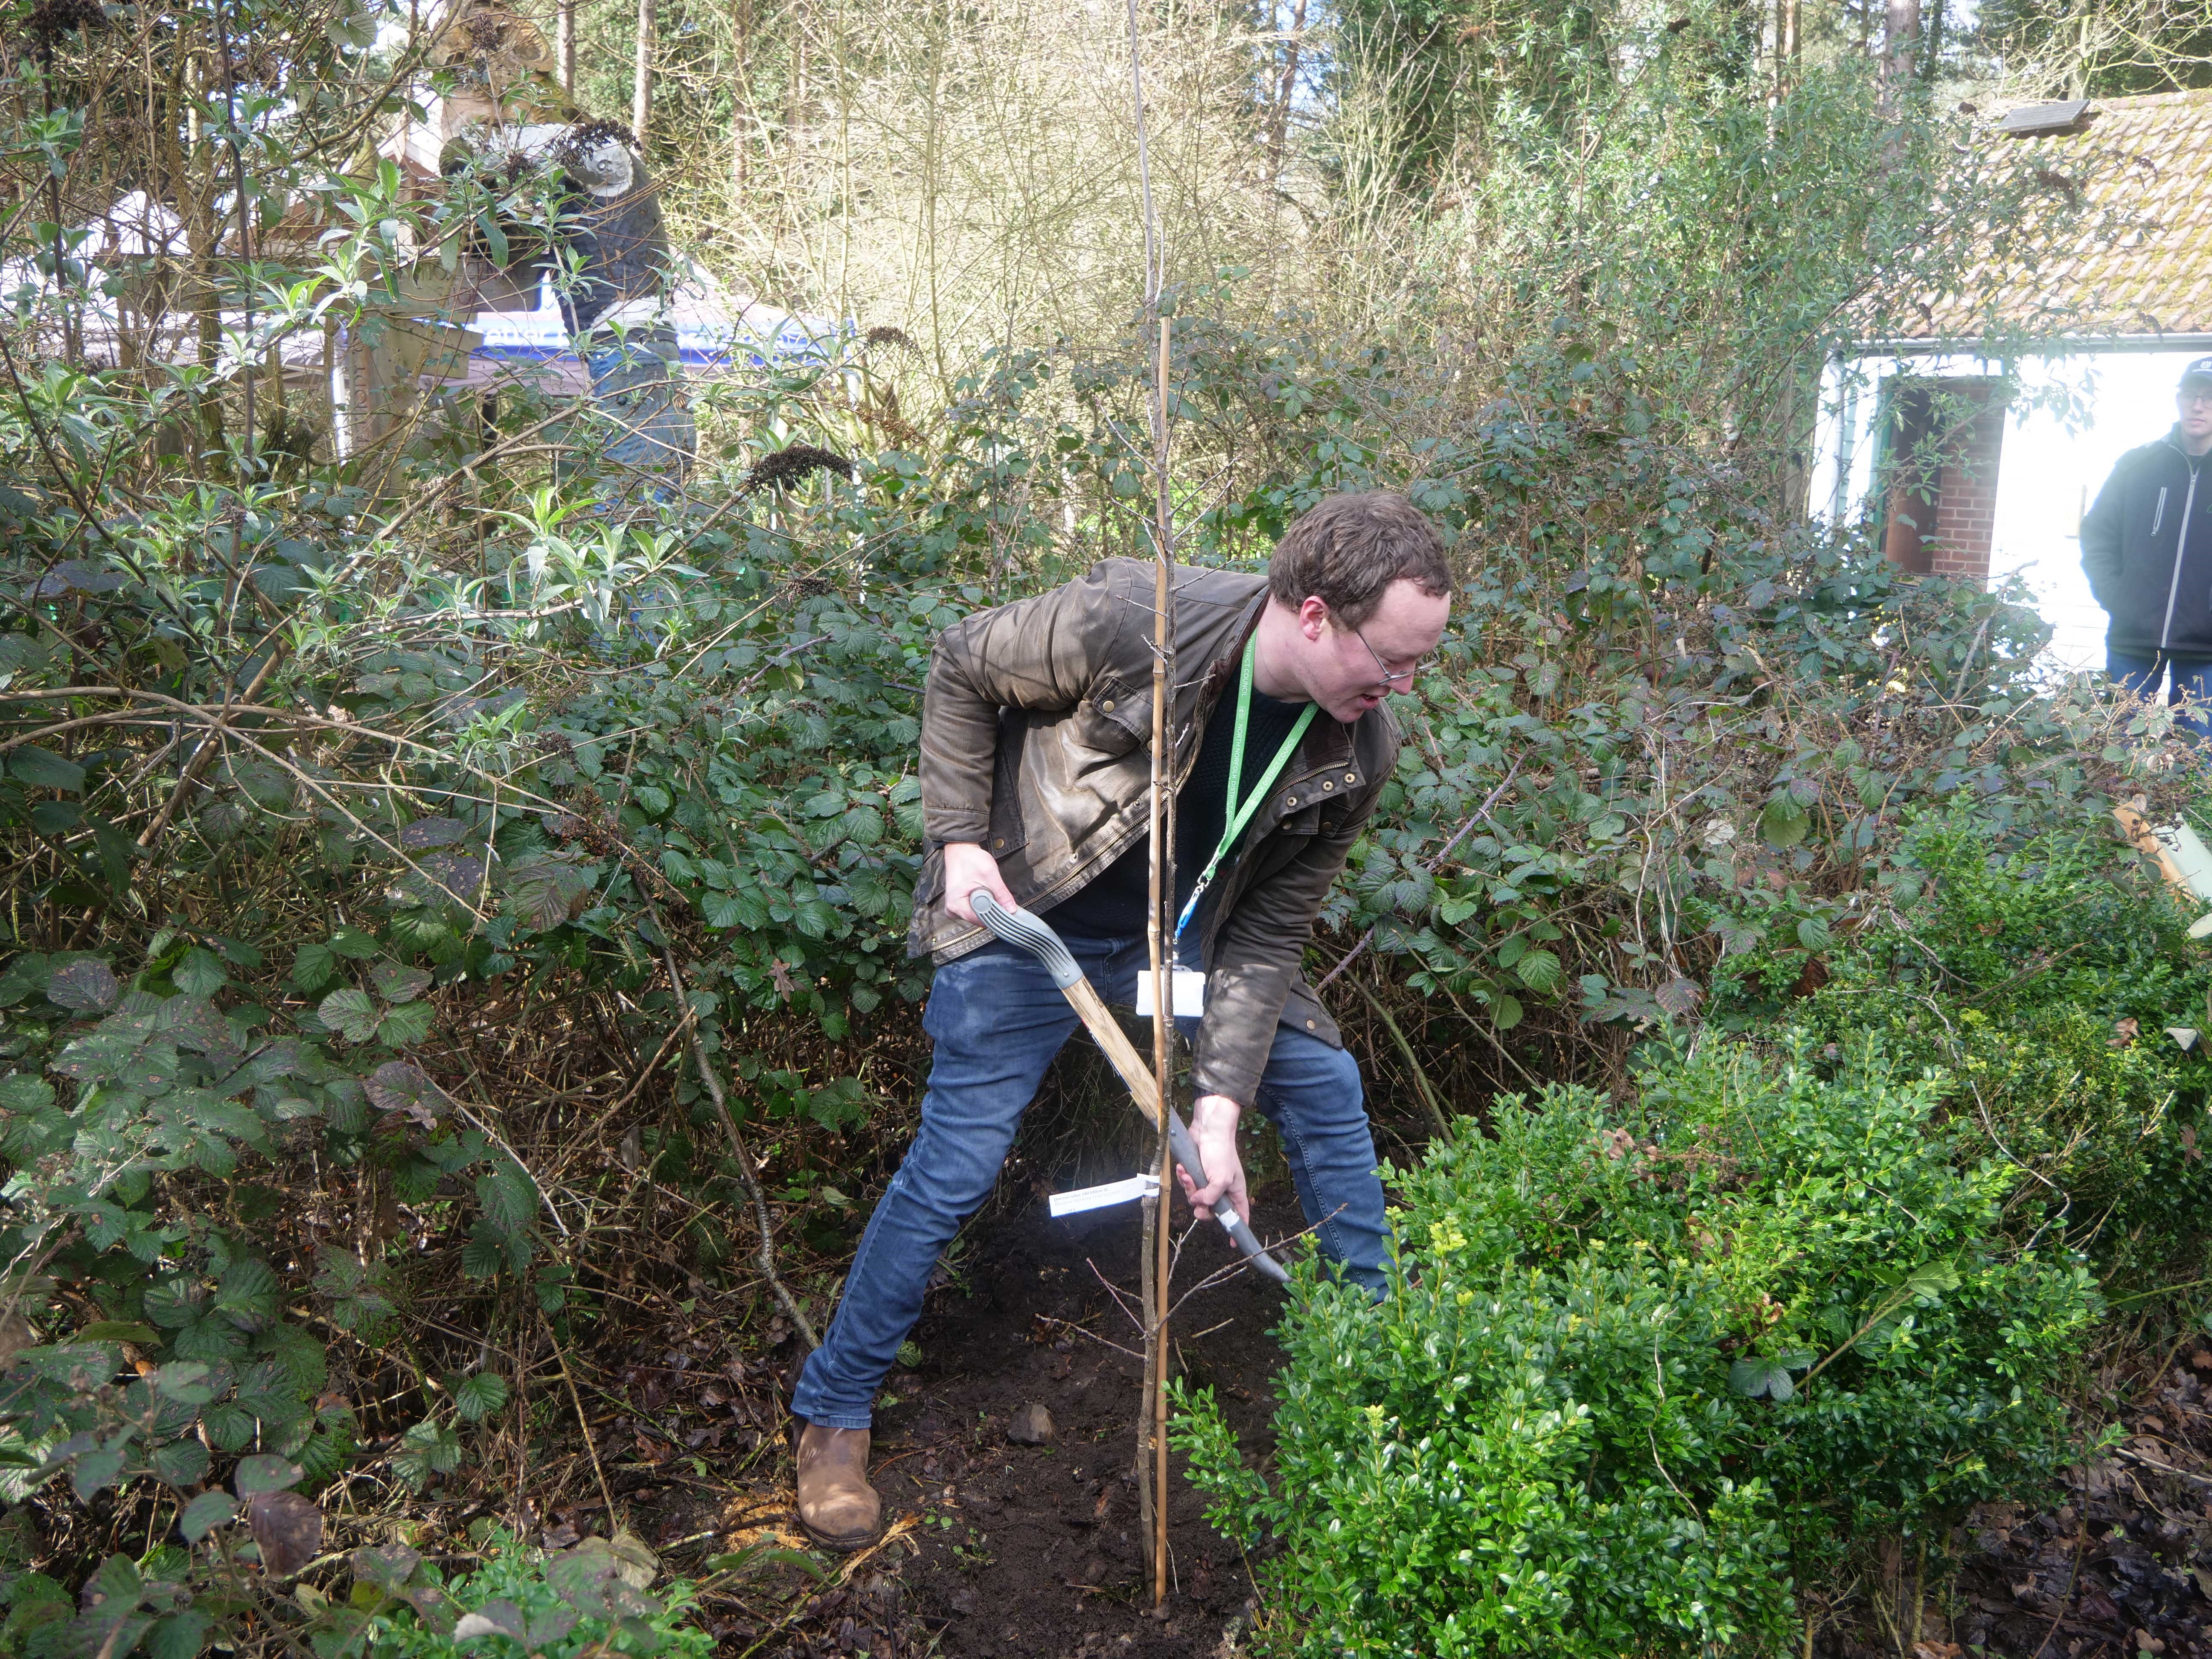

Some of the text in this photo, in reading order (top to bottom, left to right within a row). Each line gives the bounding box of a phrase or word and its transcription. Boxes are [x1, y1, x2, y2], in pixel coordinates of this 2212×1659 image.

[1241, 669, 1249, 697] COUNCIL
[1232, 748, 1240, 779] NORFOLK
[1232, 738, 1296, 832] NORTH NORFOLK DISTRICT COUNCIL
